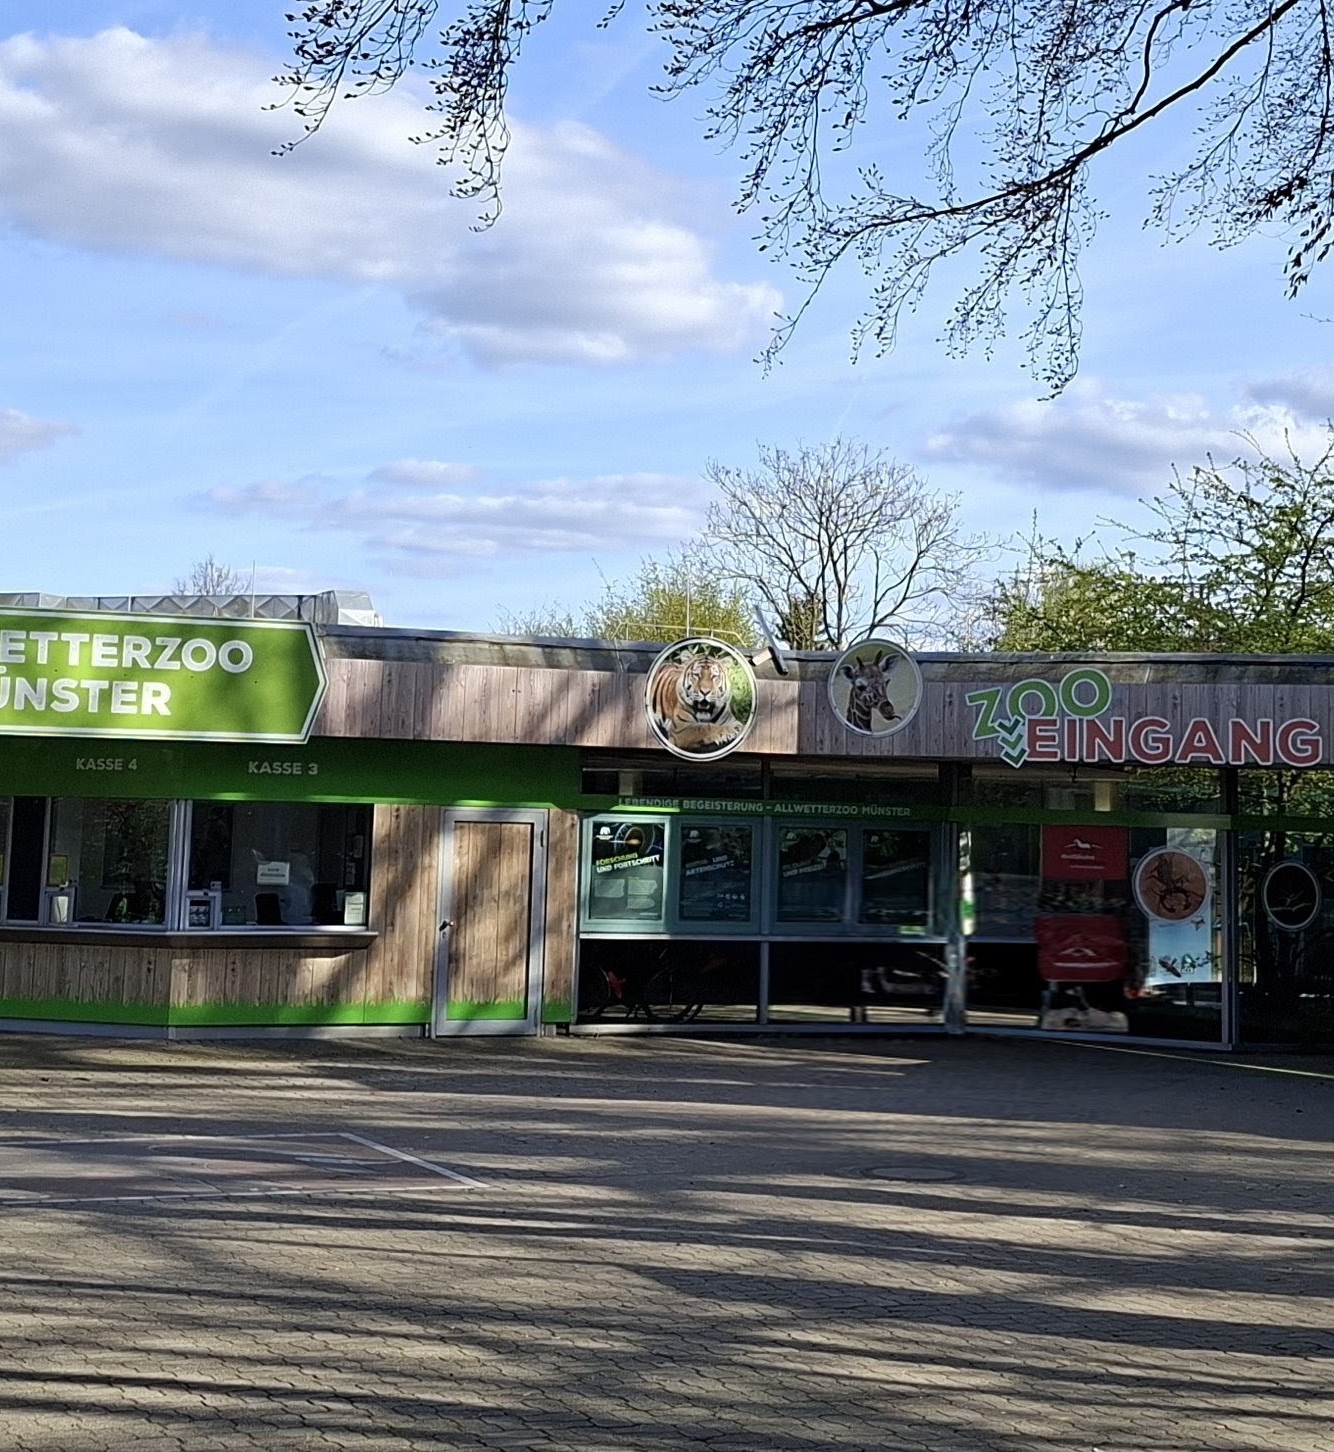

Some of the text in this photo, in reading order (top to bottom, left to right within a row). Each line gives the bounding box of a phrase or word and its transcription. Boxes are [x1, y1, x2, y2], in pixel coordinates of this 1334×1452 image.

[965, 668, 1113, 741] ZOO
[1026, 716, 1323, 767] EINGANG
[75, 757, 138, 771] KASSE 4
[247, 760, 318, 775] KASSE 3
[618, 798, 680, 809] LEBENDIGE
[682, 799, 764, 813] BEGEISTERUNG
[774, 803, 859, 816] ALLWETTERZOO
[861, 805, 912, 817] MÜNSTER
